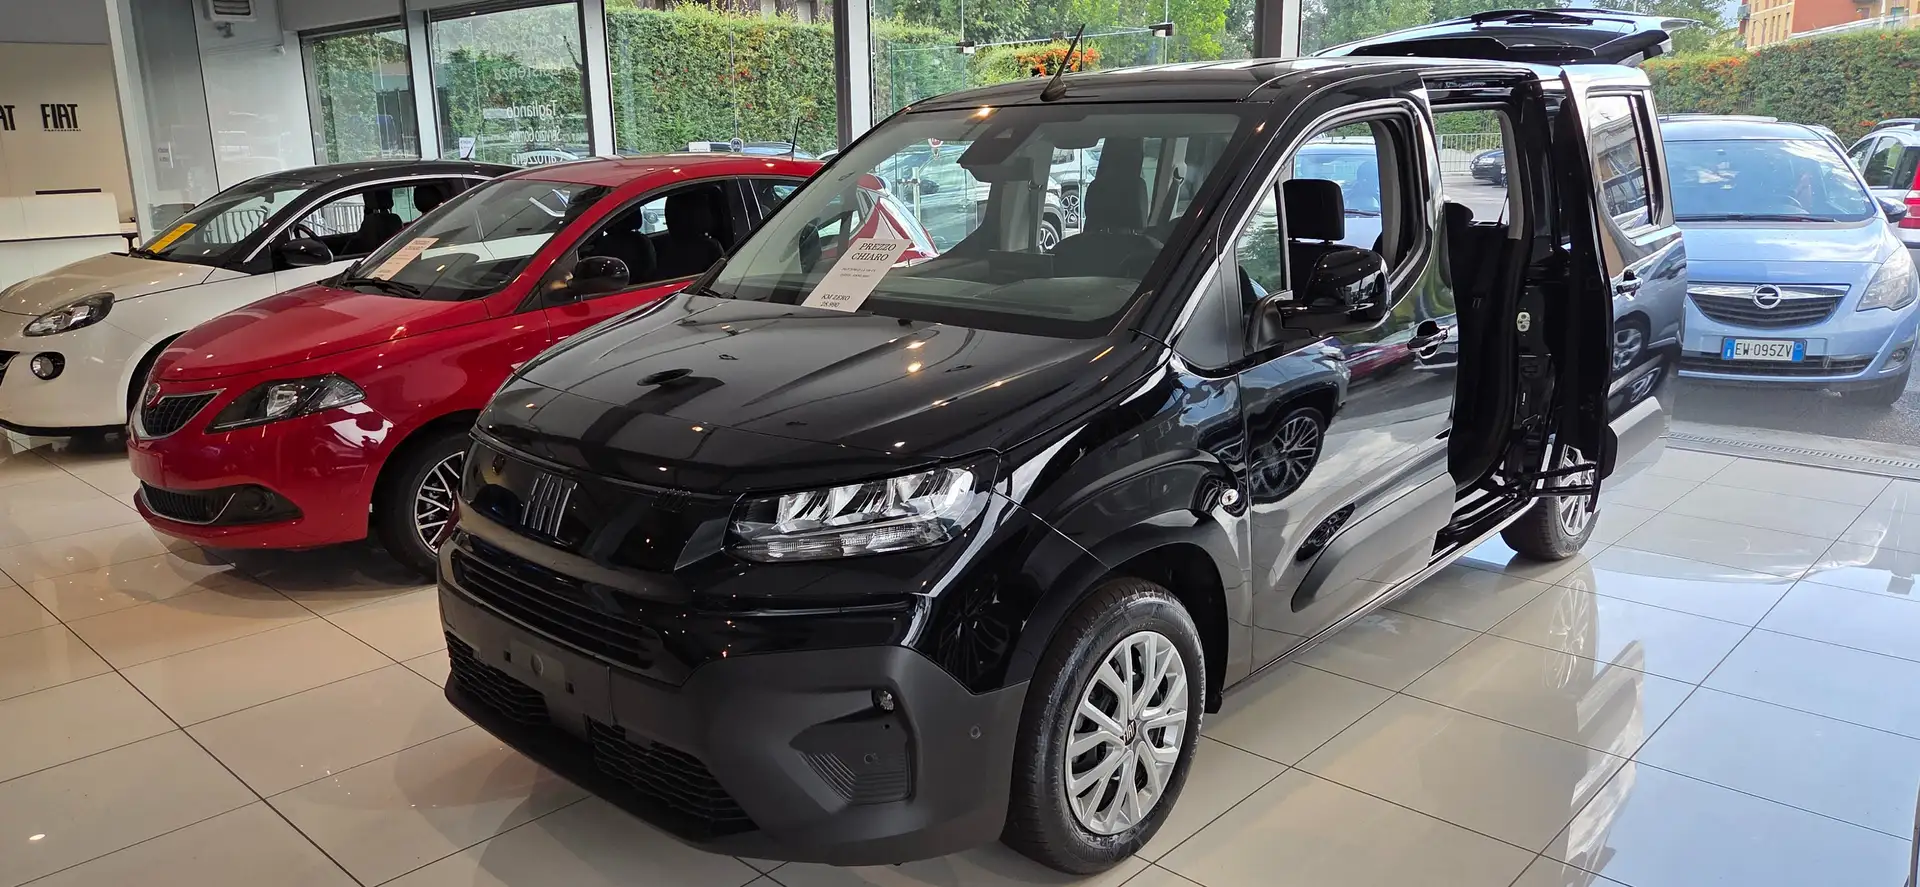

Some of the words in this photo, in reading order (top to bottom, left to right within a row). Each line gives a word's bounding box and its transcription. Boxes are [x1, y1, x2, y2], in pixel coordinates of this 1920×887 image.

[40, 104, 79, 129] FIAT
[859, 242, 897, 251] PREZZO
[851, 252, 889, 261] CHIARO
[521, 472, 578, 538] FIAT
